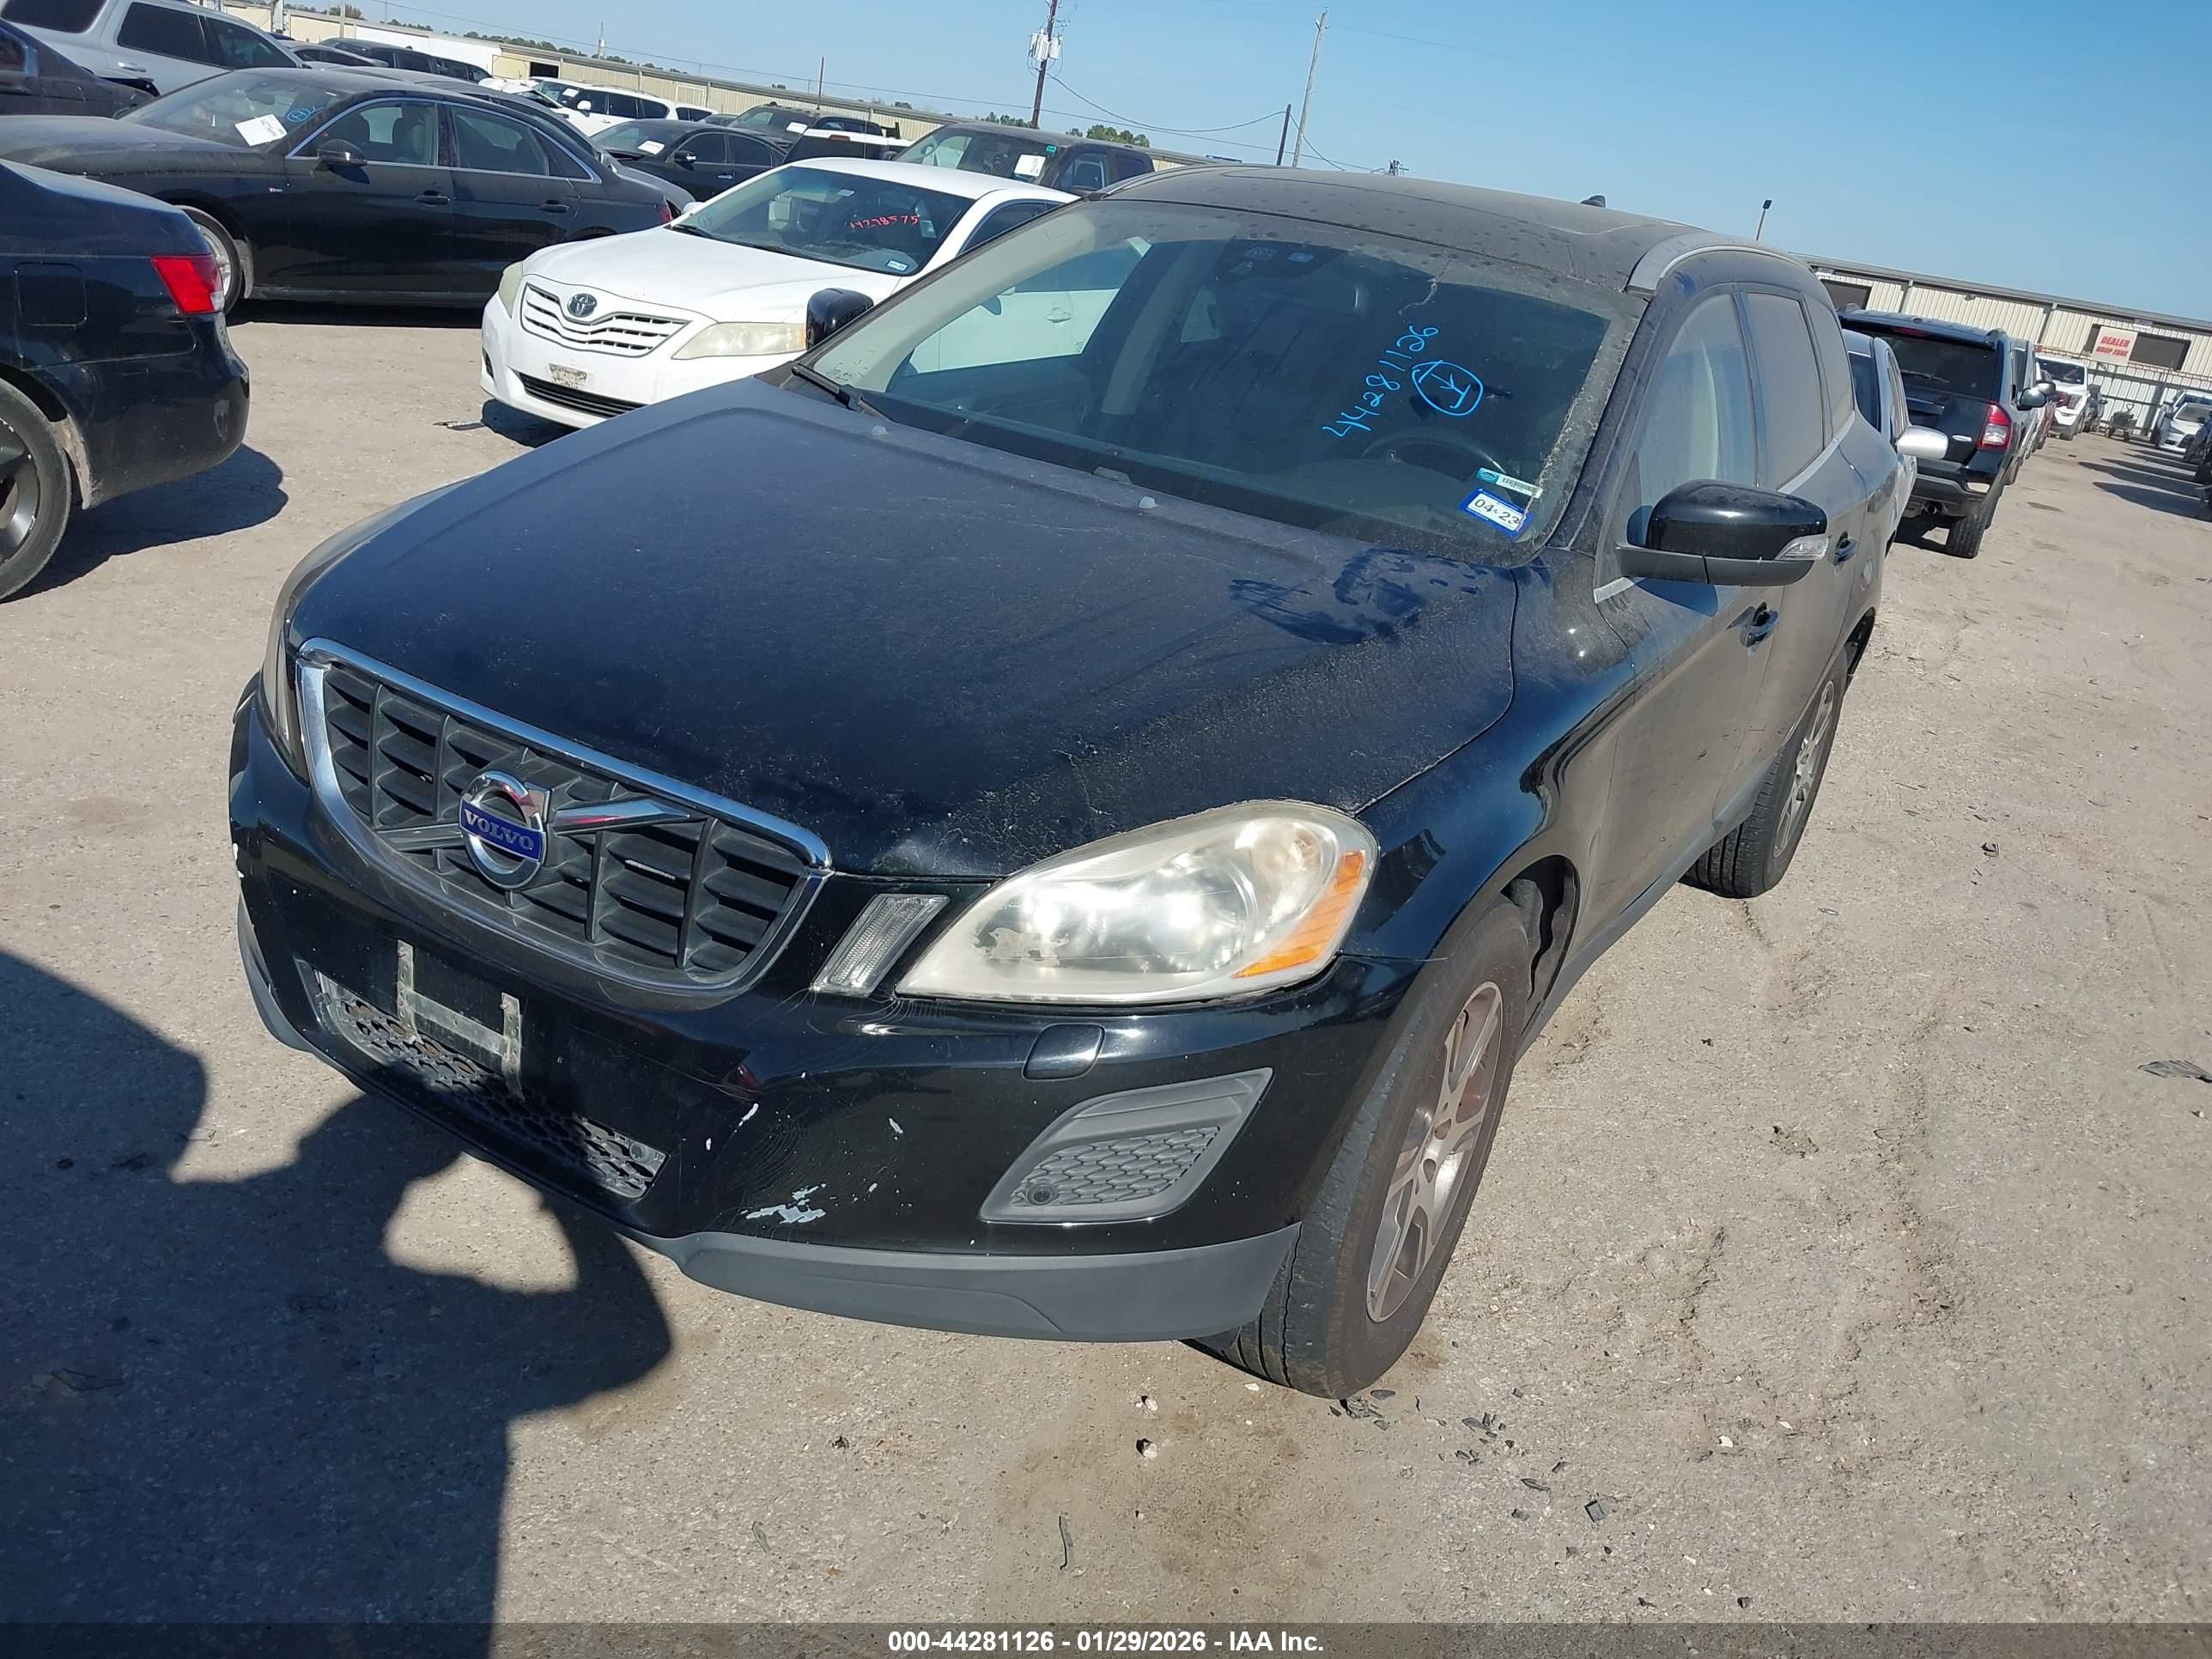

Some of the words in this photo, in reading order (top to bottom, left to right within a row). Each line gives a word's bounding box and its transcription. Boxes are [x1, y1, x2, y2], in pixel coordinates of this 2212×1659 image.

[2100, 336, 2130, 348] DEALER
[1322, 325, 1440, 437] 44281126
[464, 808, 534, 851] VOLVO
